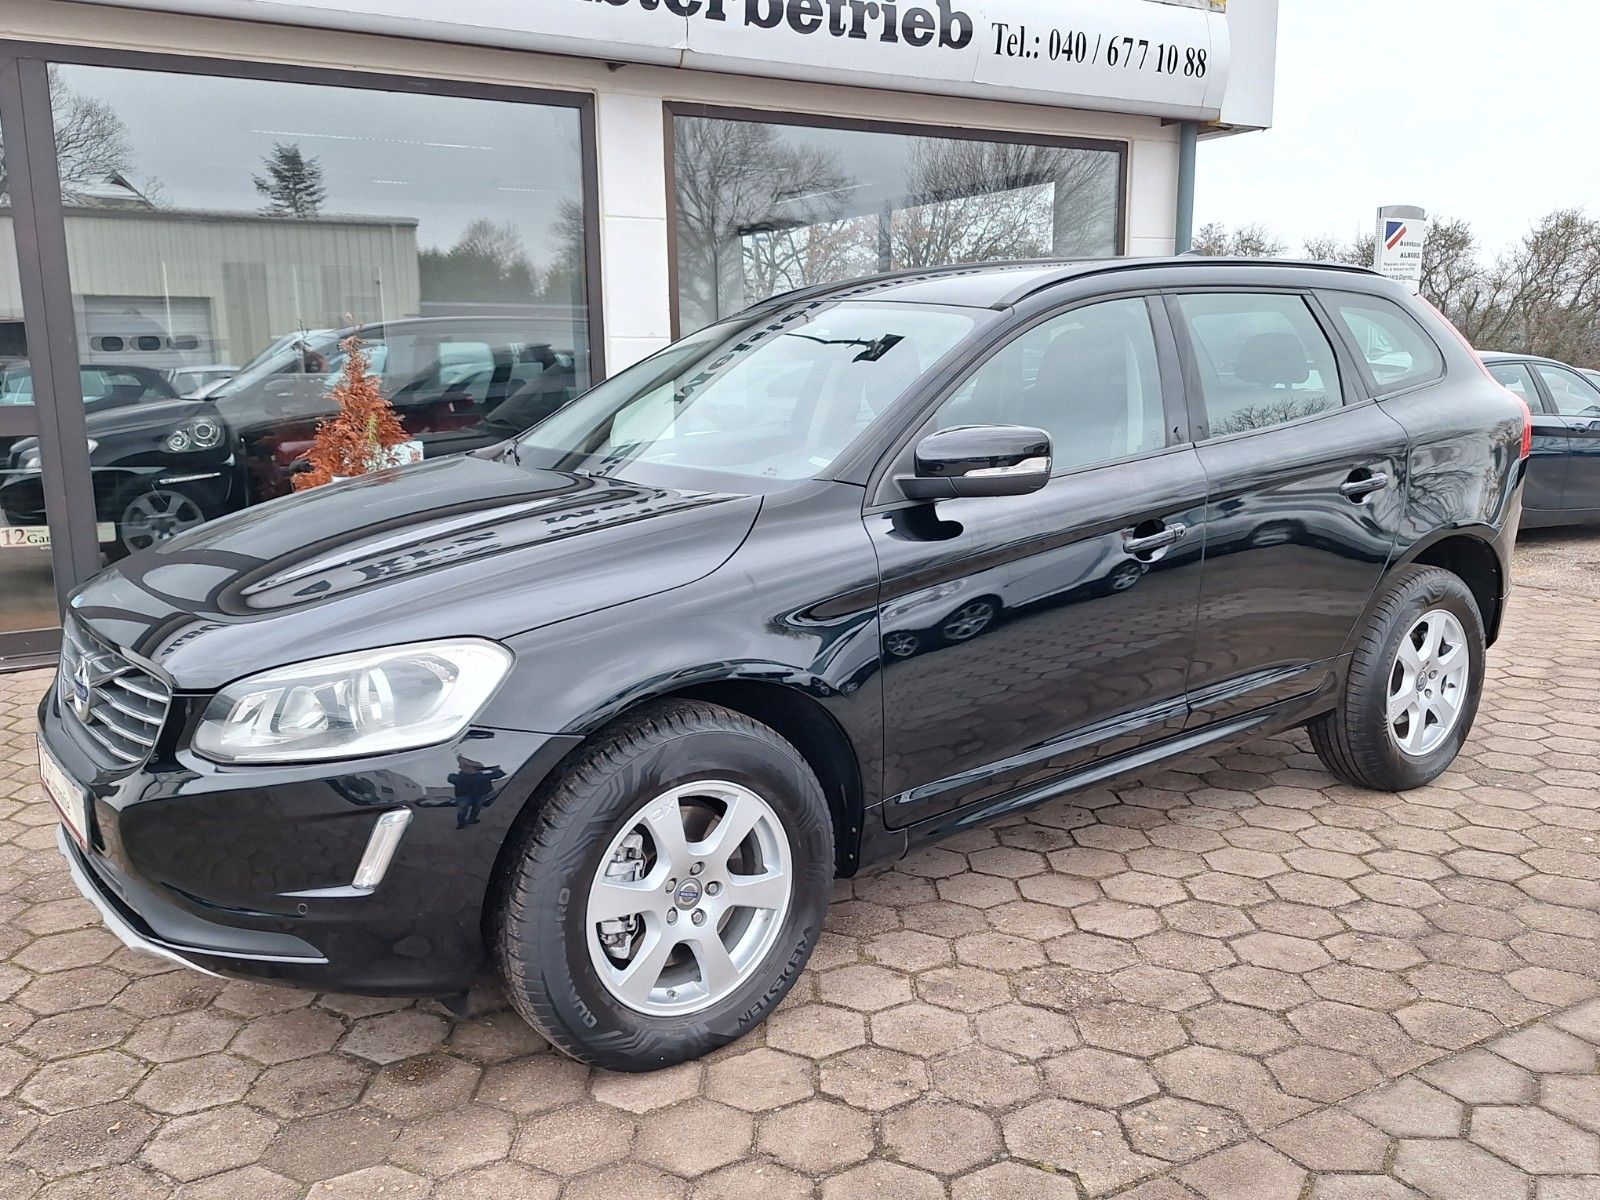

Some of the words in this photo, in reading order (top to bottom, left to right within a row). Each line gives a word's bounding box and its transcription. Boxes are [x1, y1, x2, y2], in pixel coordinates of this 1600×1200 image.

[992, 23, 1040, 59] Tel.:
[1050, 29, 1087, 63] 040
[1107, 36, 1149, 70] 677
[1155, 43, 1178, 74] 10
[1183, 47, 1207, 78] 88
[1, 529, 27, 546] 12
